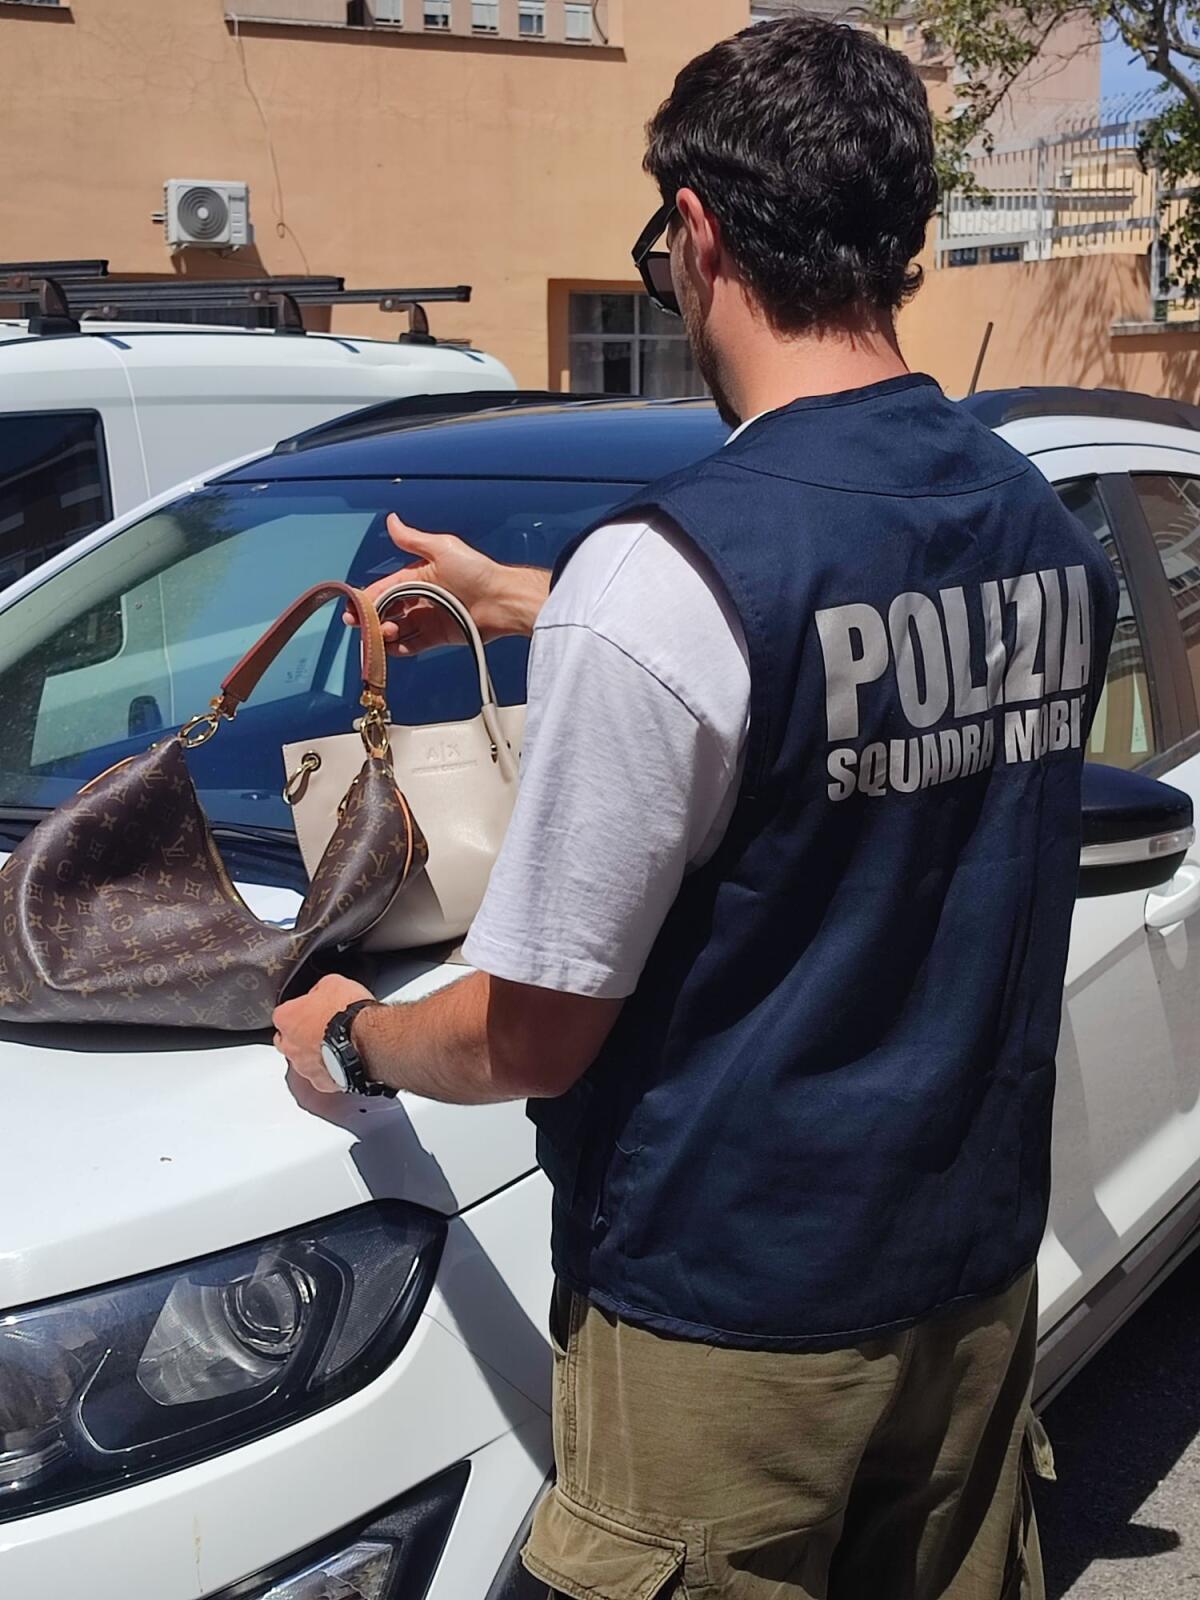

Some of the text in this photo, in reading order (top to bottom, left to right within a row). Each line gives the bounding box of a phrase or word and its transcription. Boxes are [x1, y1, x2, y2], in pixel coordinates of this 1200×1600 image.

[815, 565, 1091, 742] POLIZIA
[827, 694, 1086, 802] SQUADRA MOBI
